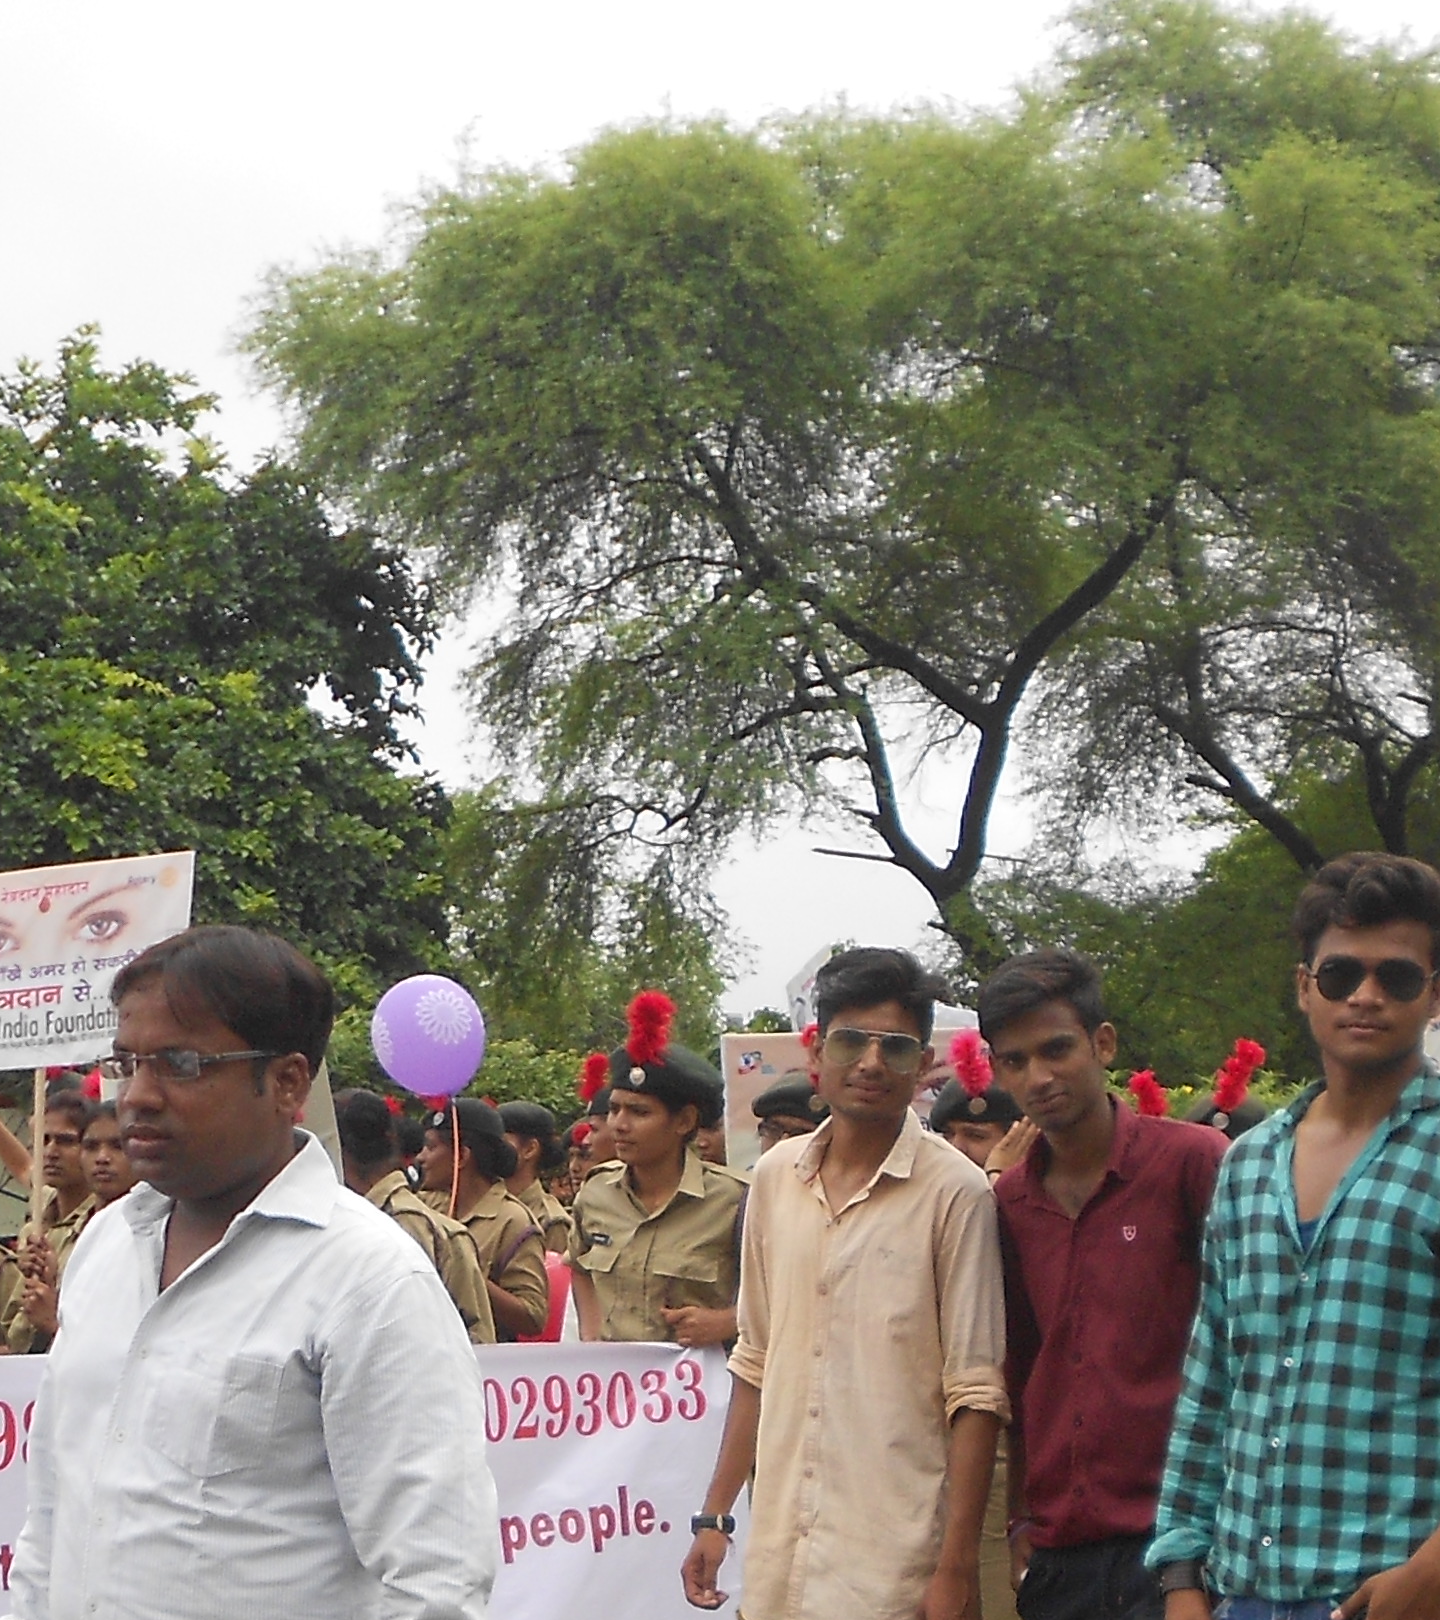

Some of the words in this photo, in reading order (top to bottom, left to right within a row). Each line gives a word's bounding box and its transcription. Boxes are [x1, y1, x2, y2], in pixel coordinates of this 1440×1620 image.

[29, 963, 66, 980] अमर
[72, 956, 86, 975] हो
[45, 1003, 118, 1036] Foundati
[482, 1358, 709, 1443] 0293033
[499, 1484, 672, 1565] people.
